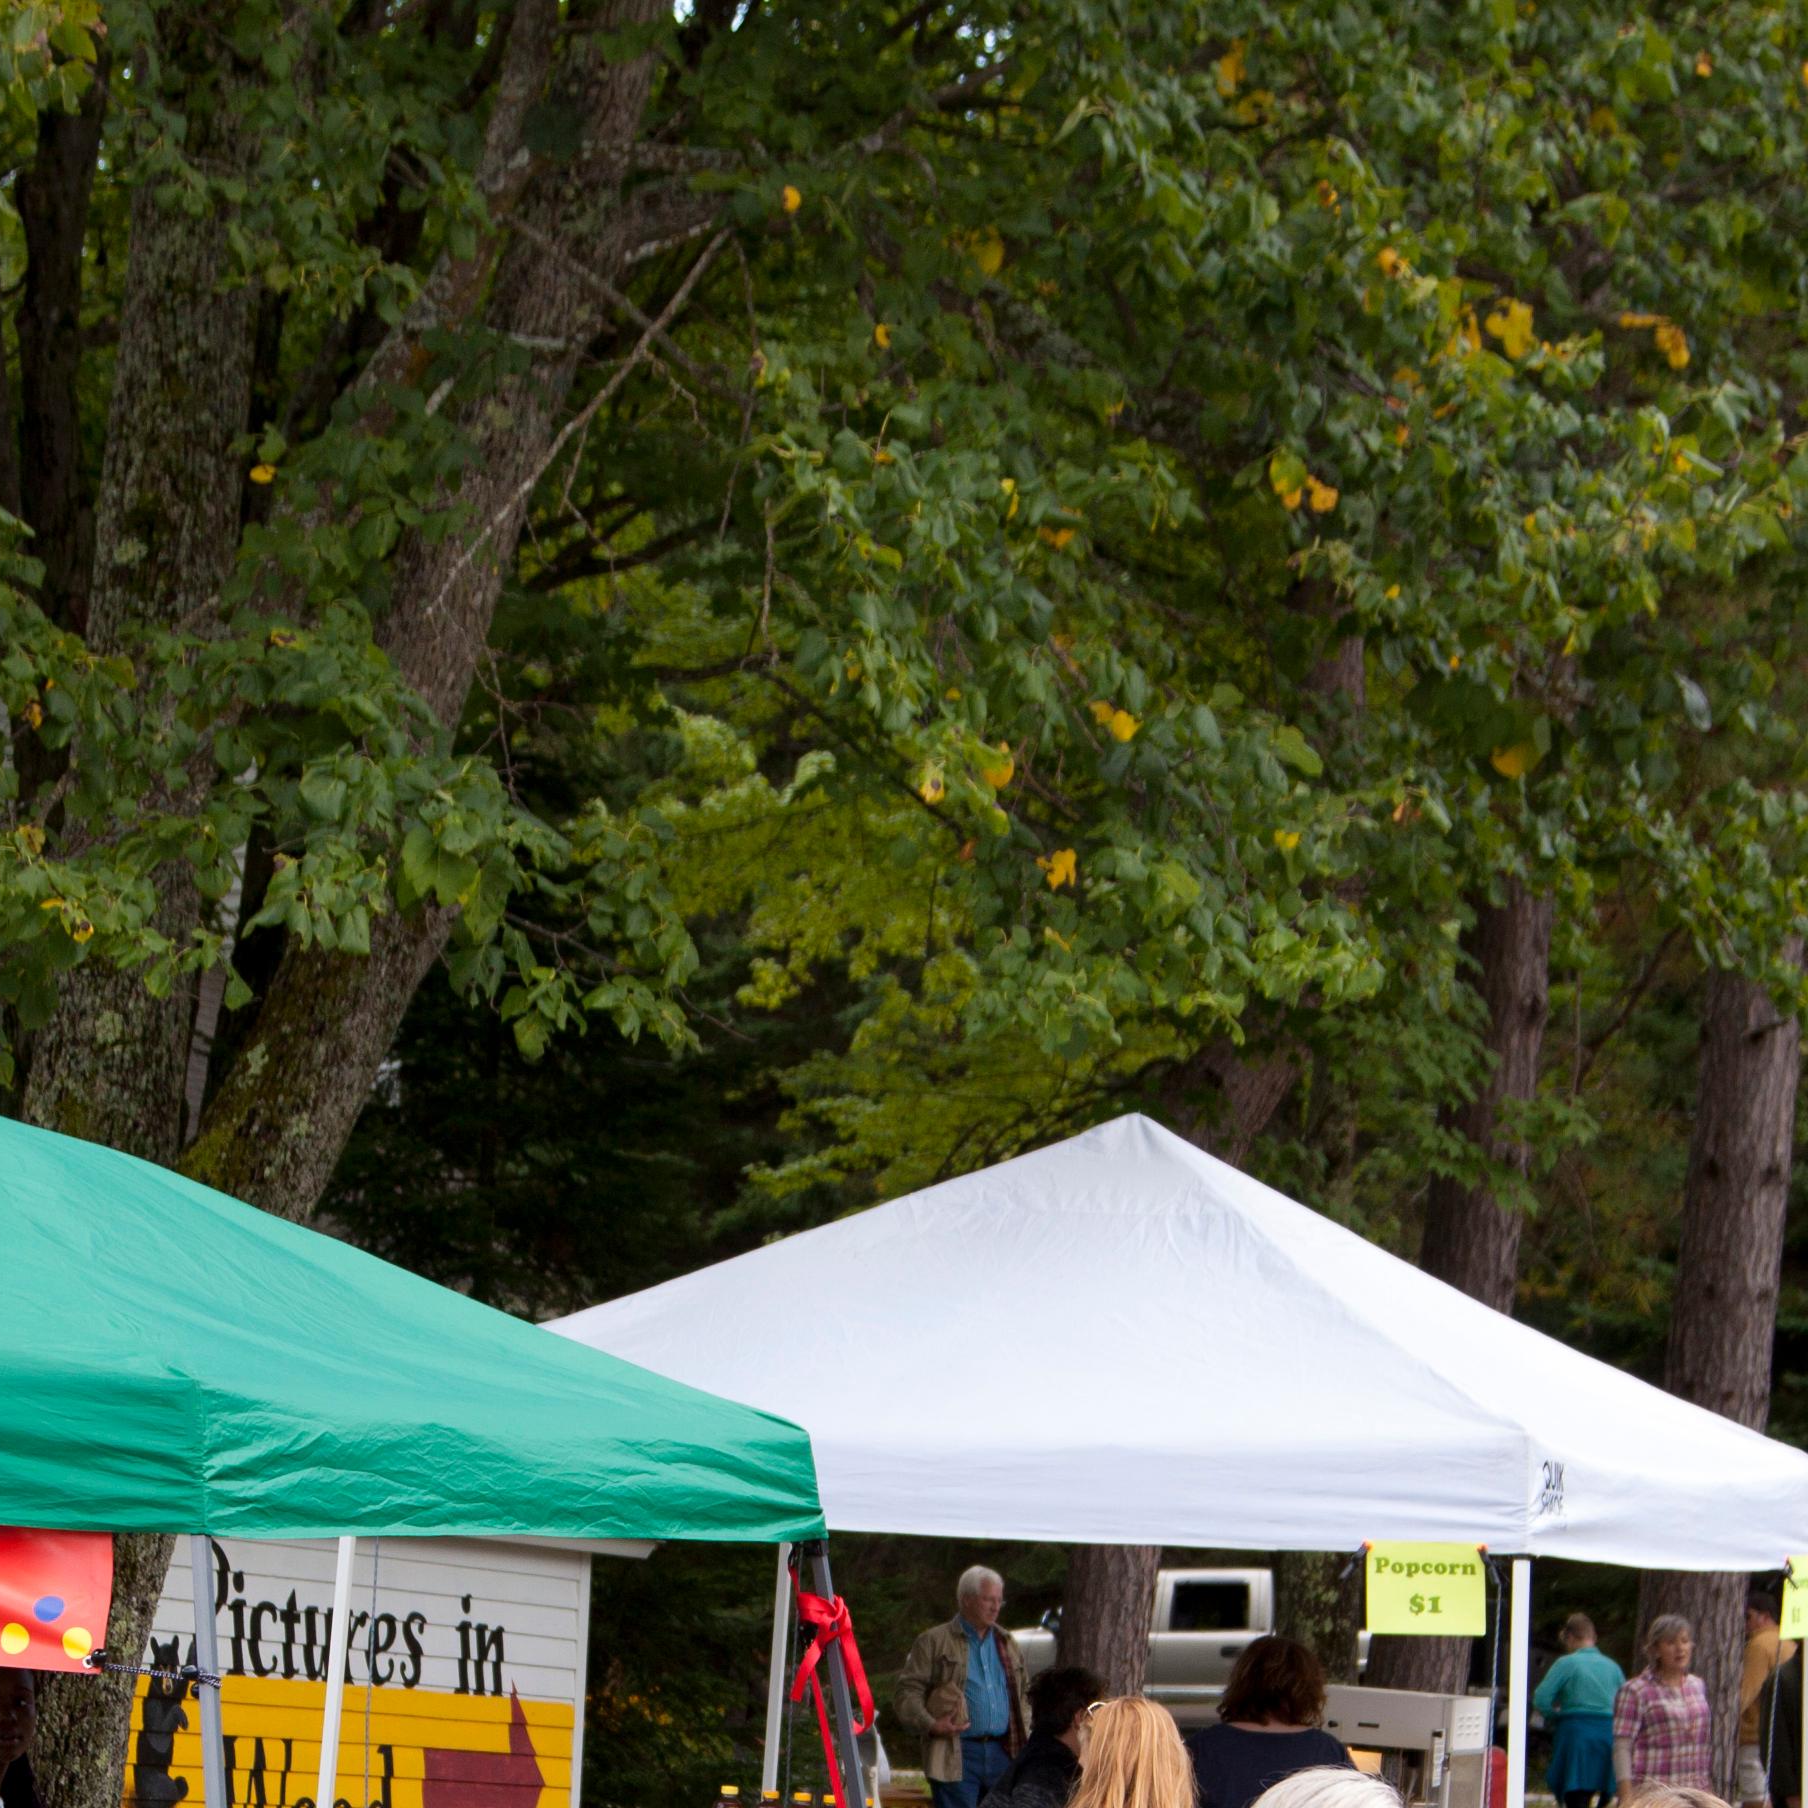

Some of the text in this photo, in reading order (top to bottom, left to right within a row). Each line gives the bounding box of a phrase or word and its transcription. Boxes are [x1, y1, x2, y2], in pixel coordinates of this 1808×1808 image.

[1374, 1556, 1477, 1578] Popcorn
[1408, 1593, 1443, 1616] $1
[453, 1592, 506, 1697] in
